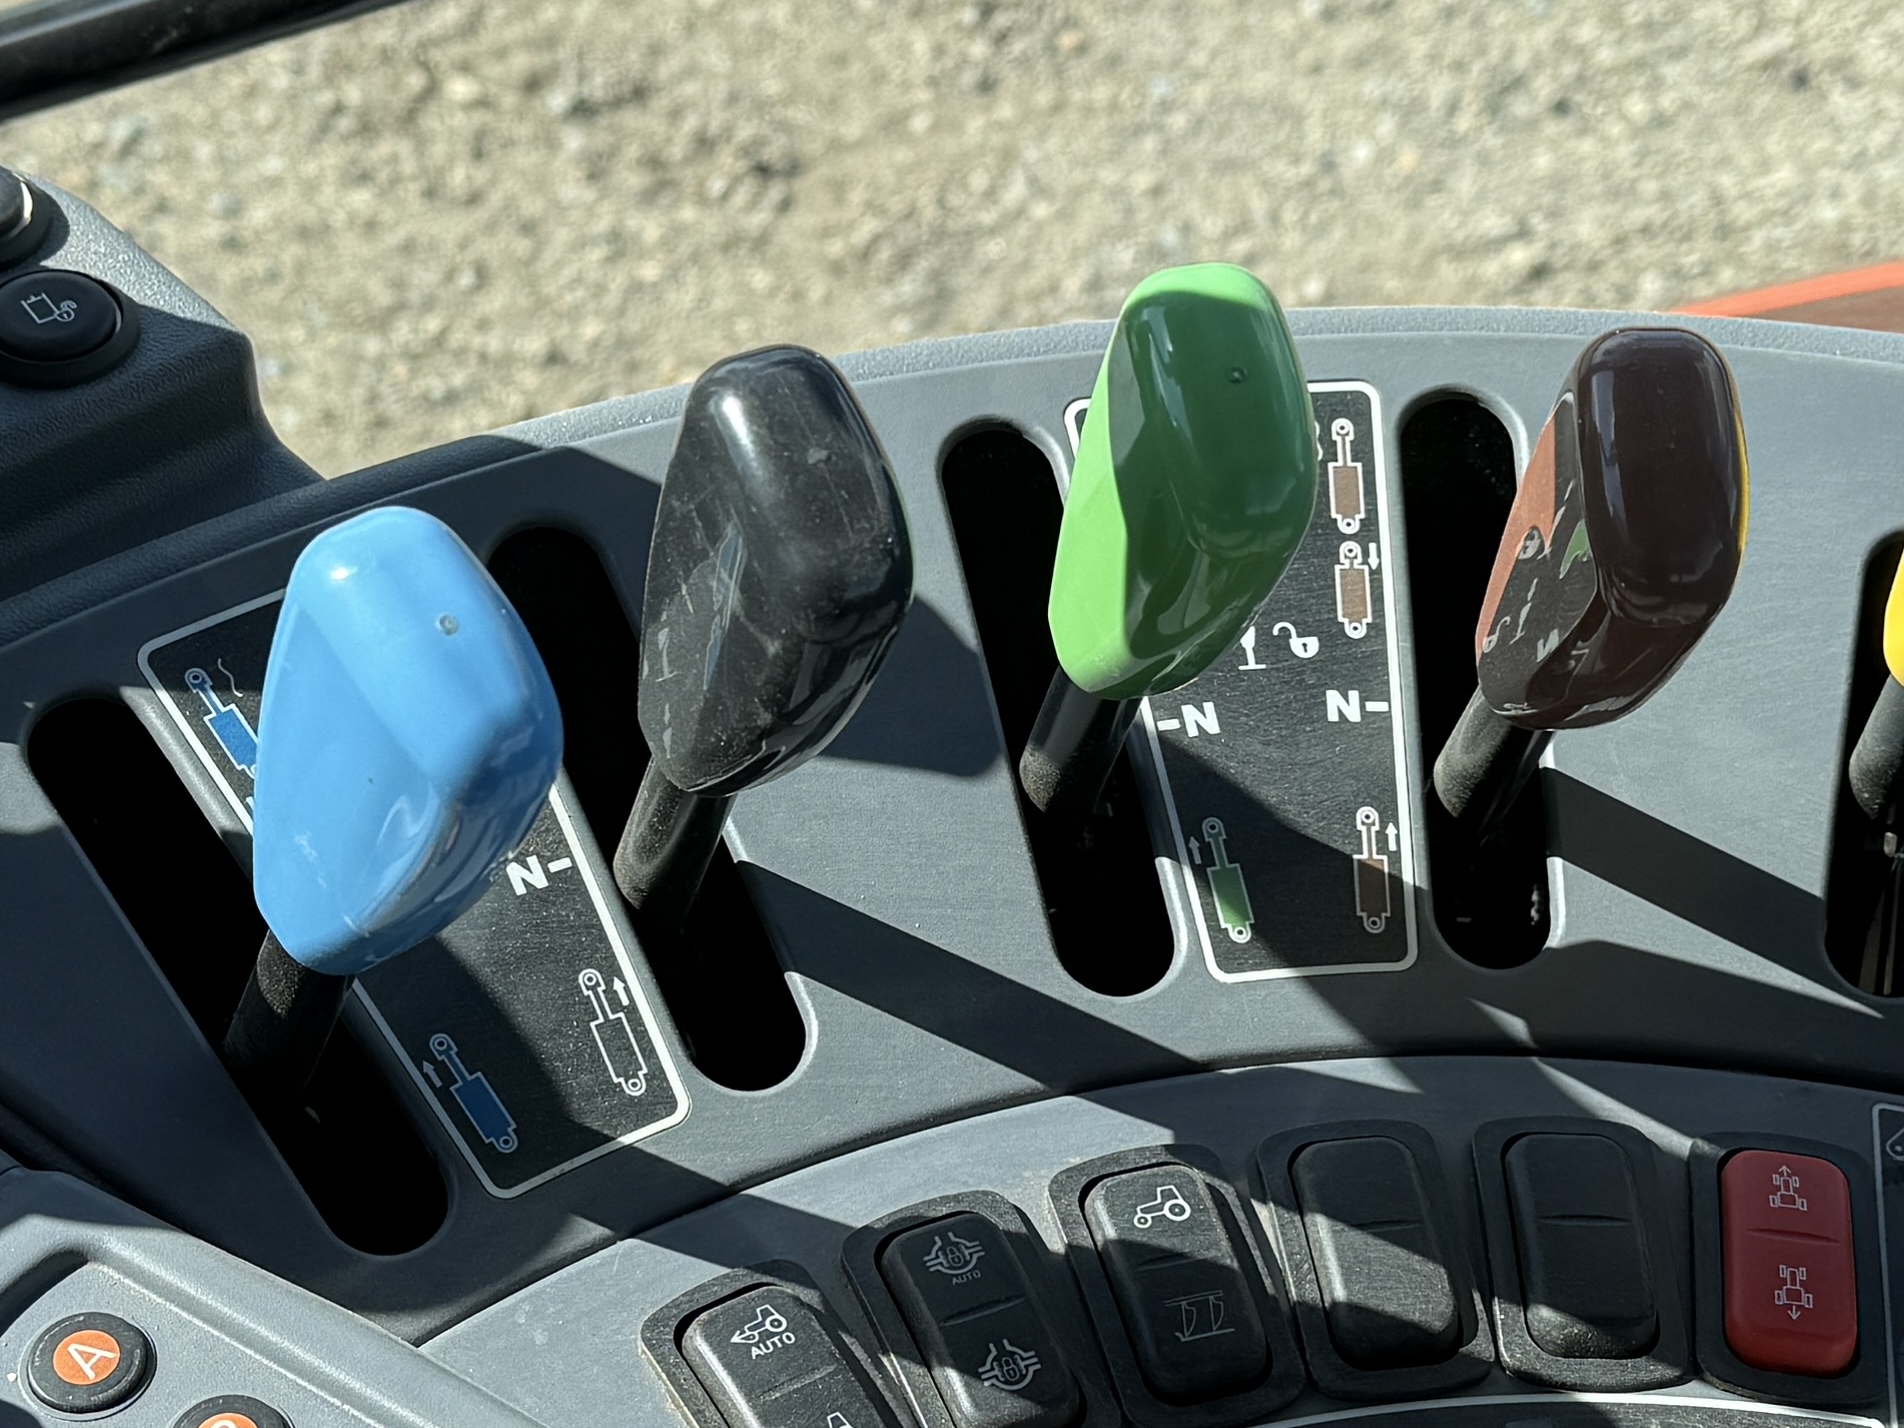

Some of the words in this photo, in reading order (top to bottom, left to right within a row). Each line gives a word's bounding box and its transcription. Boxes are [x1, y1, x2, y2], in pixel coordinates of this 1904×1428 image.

[1181, 702, 1220, 736] N
[1325, 689, 1362, 722] N
[505, 854, 550, 896] N
[950, 1269, 982, 1286] AUTO
[70, 1341, 121, 1379] A
[750, 1331, 797, 1360] AUTO
